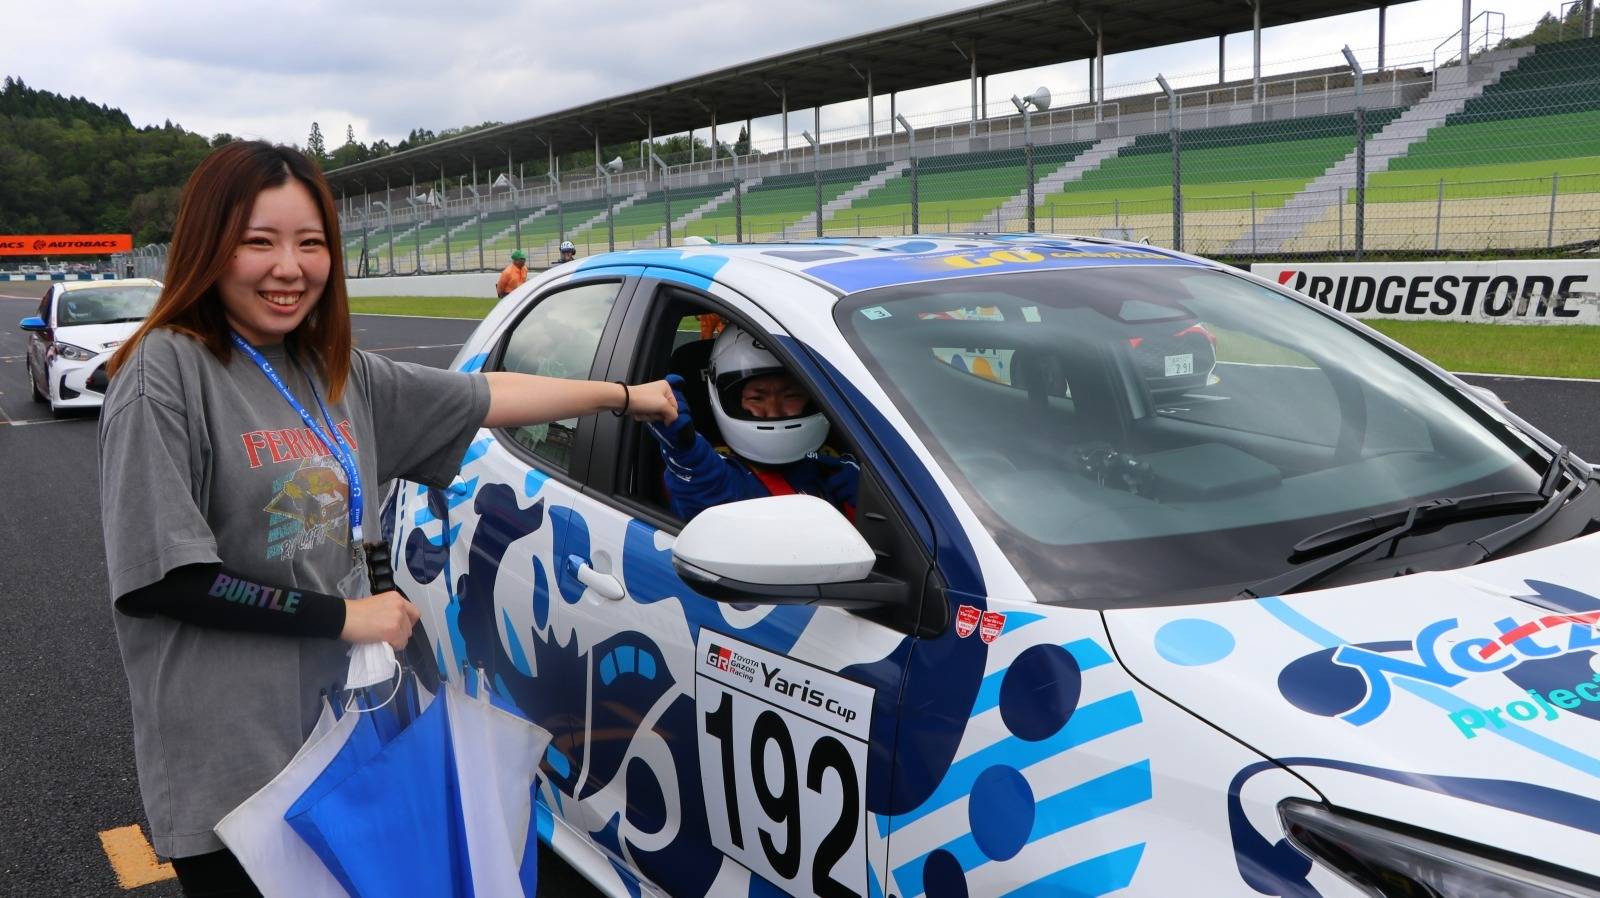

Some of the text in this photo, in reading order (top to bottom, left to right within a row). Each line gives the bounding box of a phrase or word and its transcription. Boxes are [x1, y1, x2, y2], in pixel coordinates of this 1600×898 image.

[47, 240, 118, 248] AUTOBACS
[208, 573, 302, 614] BURTLE
[706, 653, 729, 672] GR
[730, 661, 756, 675] GAZOO
[732, 652, 759, 668] TOYOTA
[729, 667, 754, 683] Racing
[760, 662, 857, 723] Yaris Cup
[705, 691, 859, 898] 192
